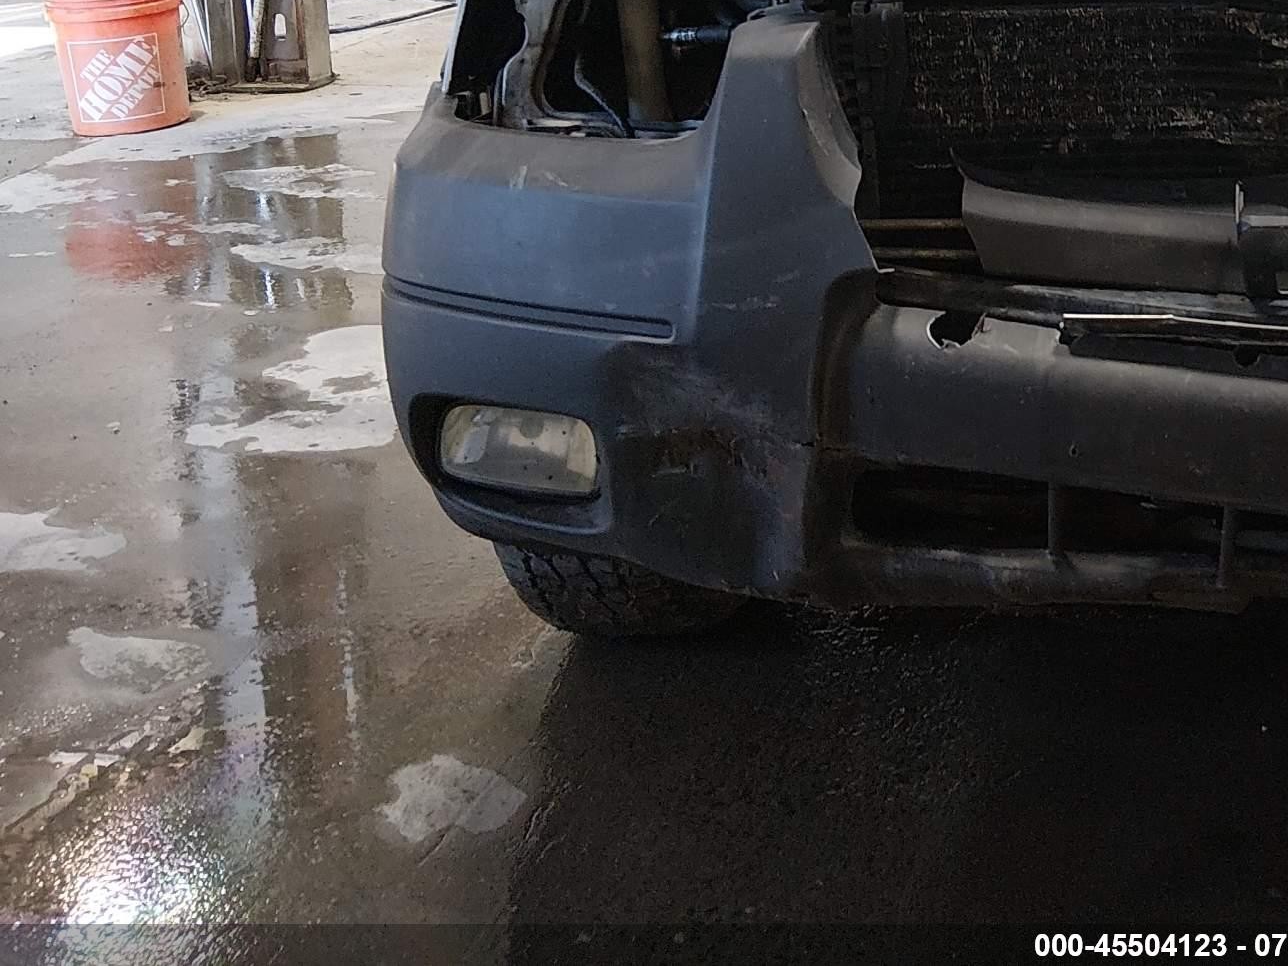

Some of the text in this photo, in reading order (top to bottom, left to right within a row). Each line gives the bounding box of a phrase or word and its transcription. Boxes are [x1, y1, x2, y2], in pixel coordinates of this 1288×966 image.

[80, 37, 157, 121] HOME
[81, 49, 114, 83] THE
[110, 64, 161, 119] DEPOT
